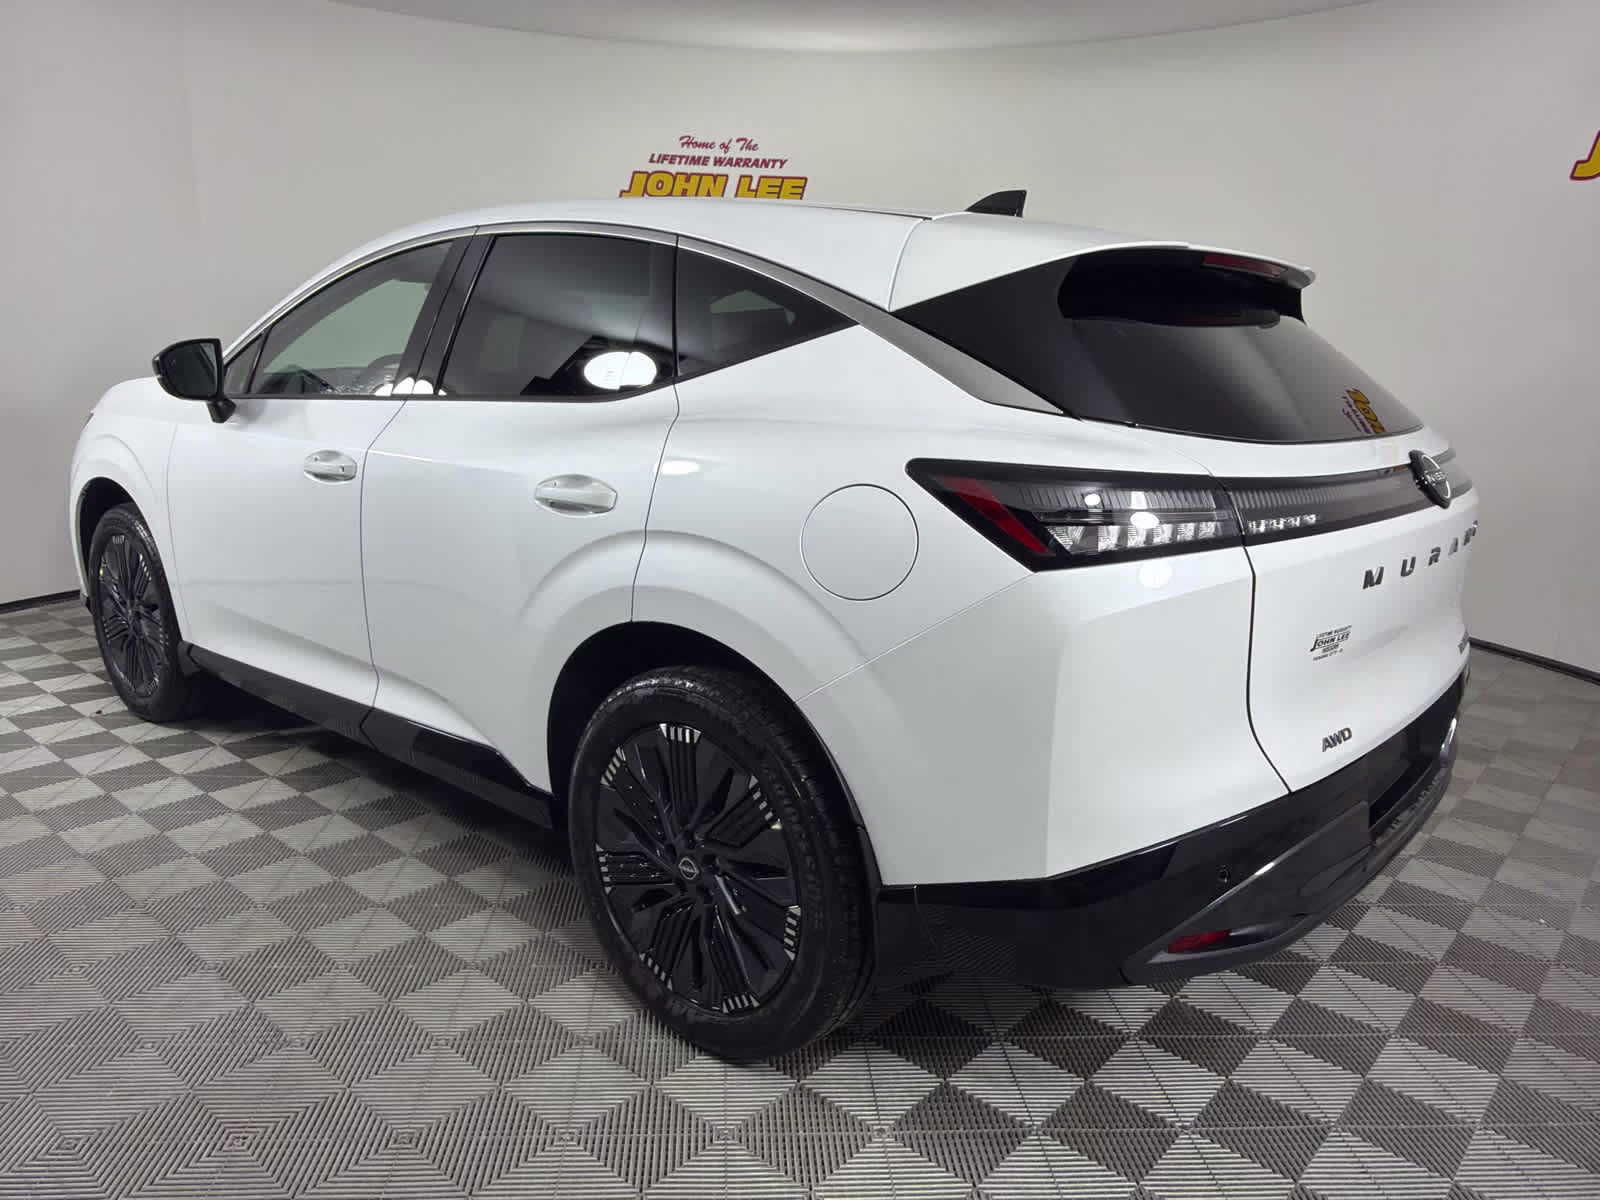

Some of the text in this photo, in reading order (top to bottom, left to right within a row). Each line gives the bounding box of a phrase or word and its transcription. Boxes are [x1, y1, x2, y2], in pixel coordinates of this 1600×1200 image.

[679, 135, 759, 154] Home of The
[649, 154, 788, 169] LIFETIME WARRANTY
[620, 171, 807, 200] JOHN LEE
[1322, 727, 1353, 753] AWD
